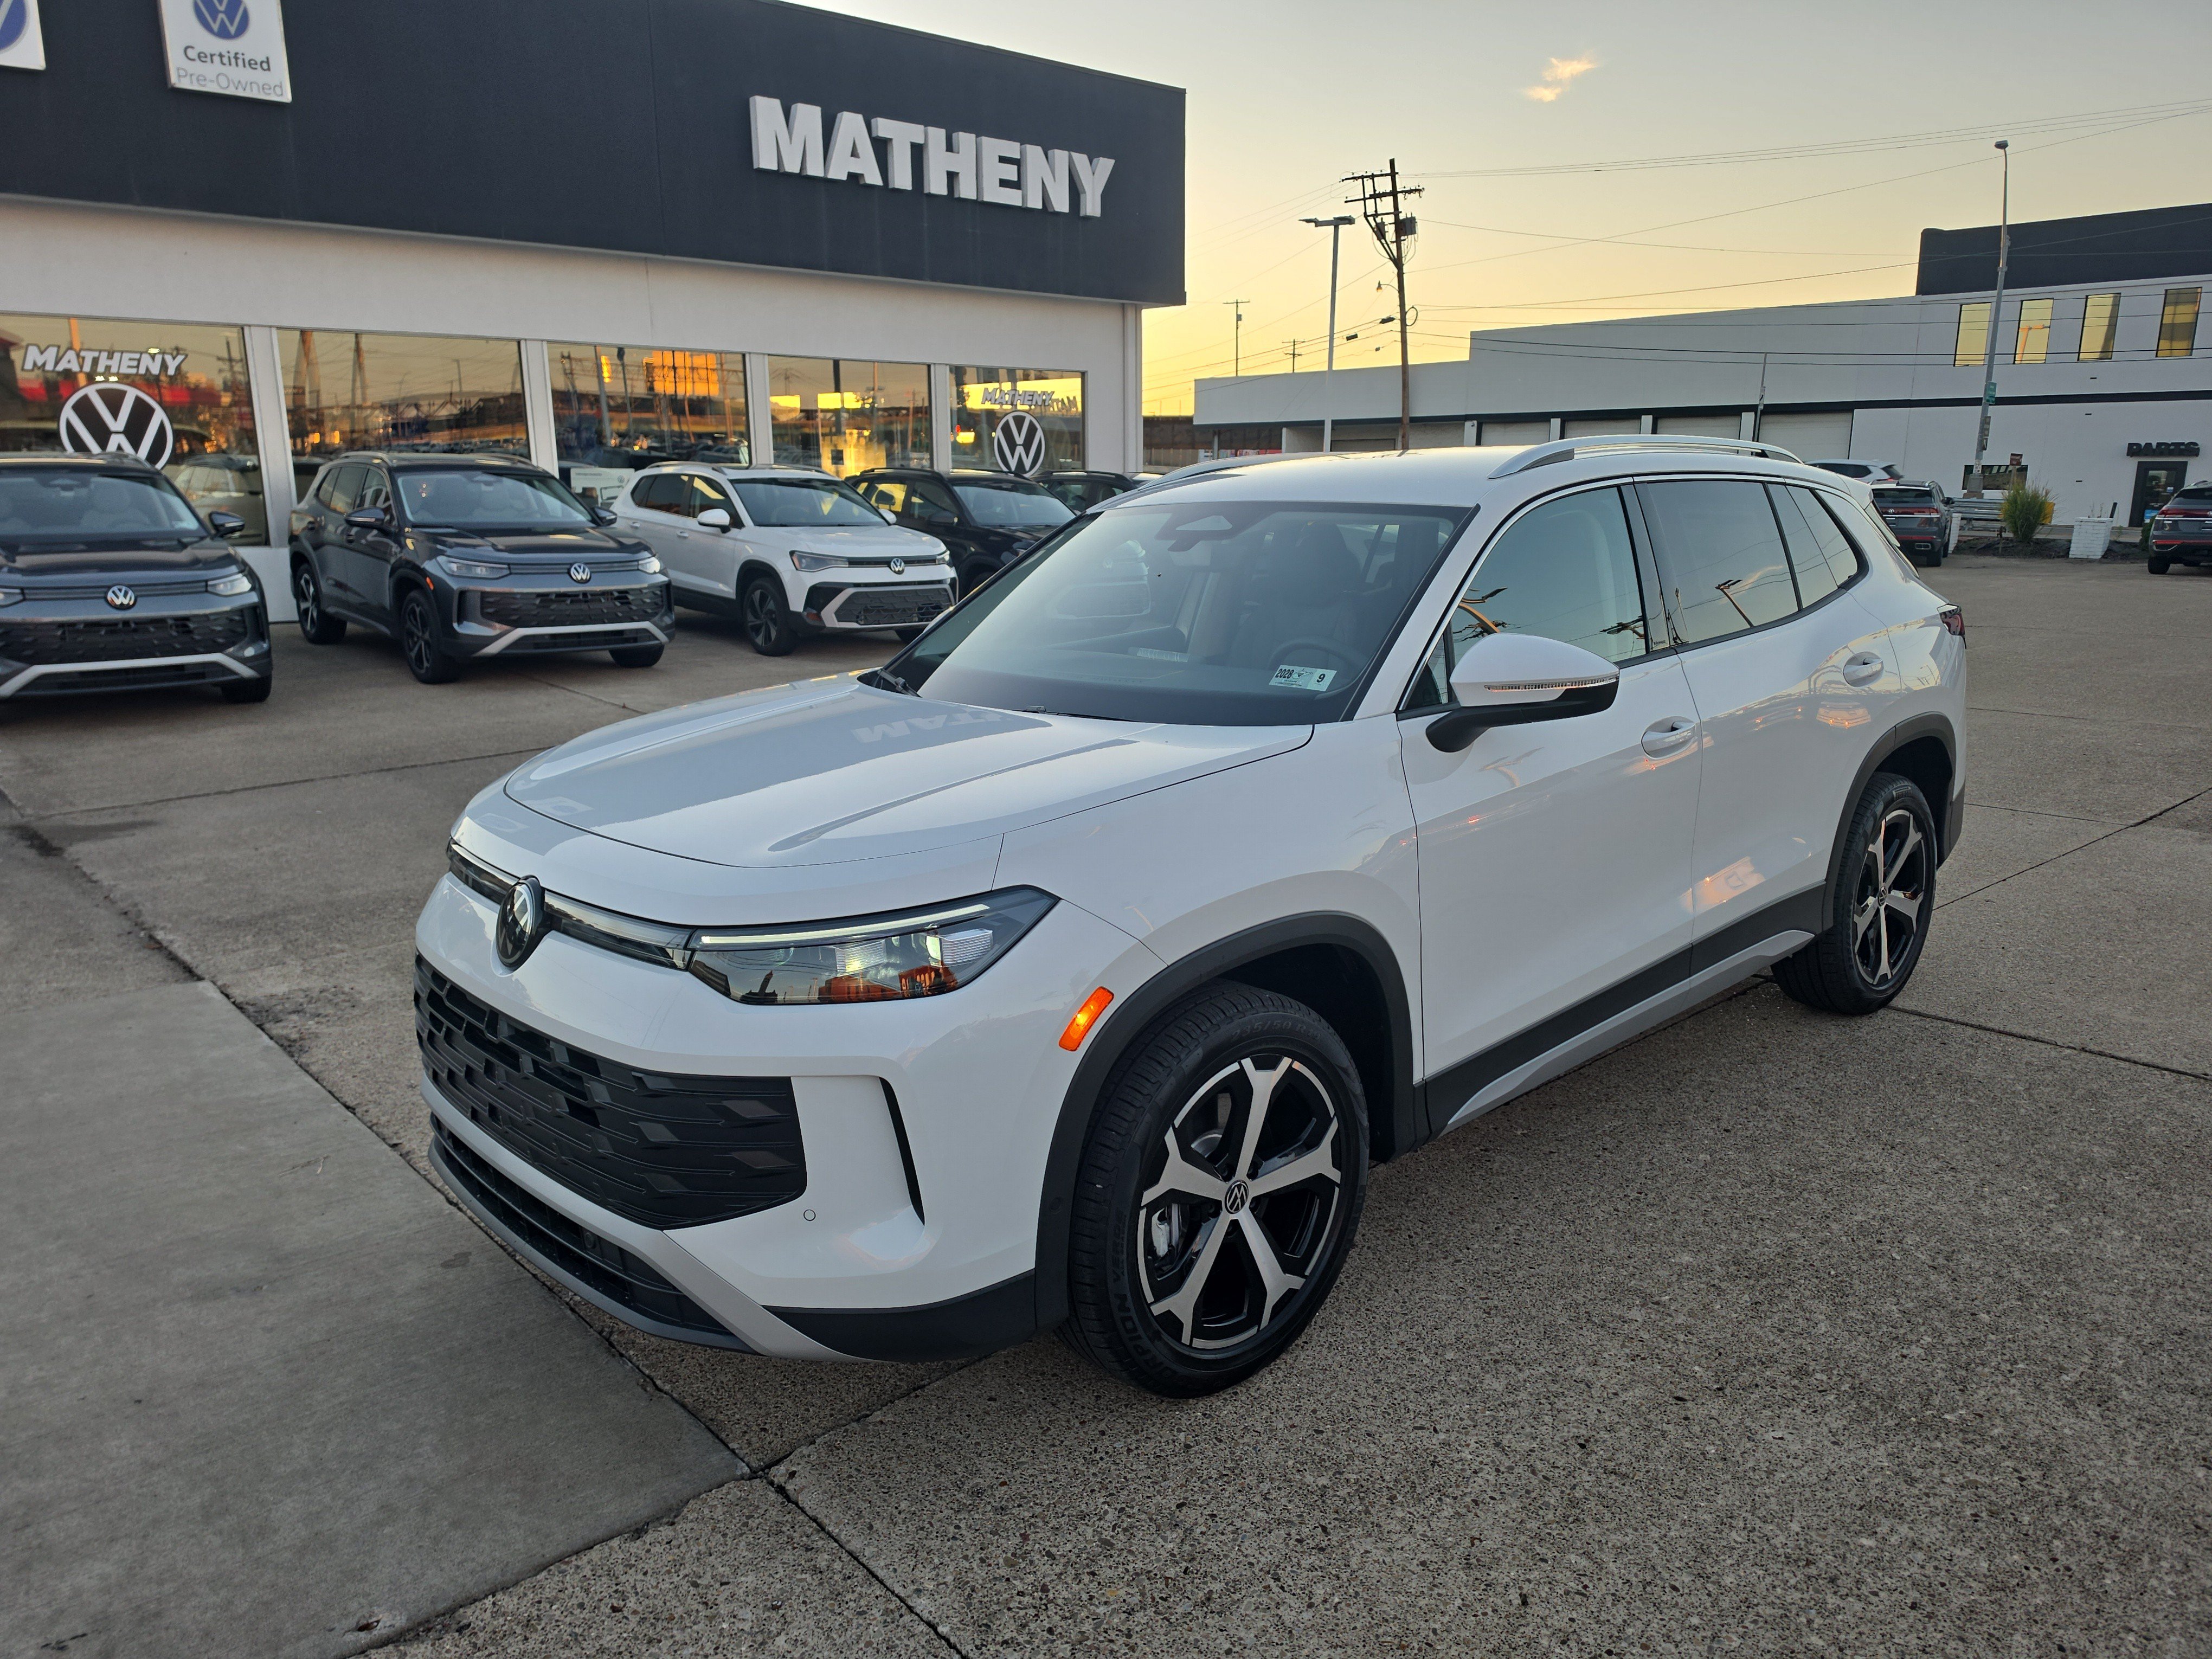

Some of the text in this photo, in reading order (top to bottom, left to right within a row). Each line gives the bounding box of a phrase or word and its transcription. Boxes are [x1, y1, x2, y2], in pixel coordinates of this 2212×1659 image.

[183, 45, 271, 72] Certified
[176, 67, 284, 97] Pre-Owned
[749, 95, 1116, 217] MATHENY
[23, 344, 187, 376] MATHENY
[981, 387, 1054, 406] MATHENY
[994, 410, 1045, 478] VW
[2126, 441, 2200, 457] PARTS
[1275, 668, 1294, 679] 2028
[1316, 673, 1326, 683] 9
